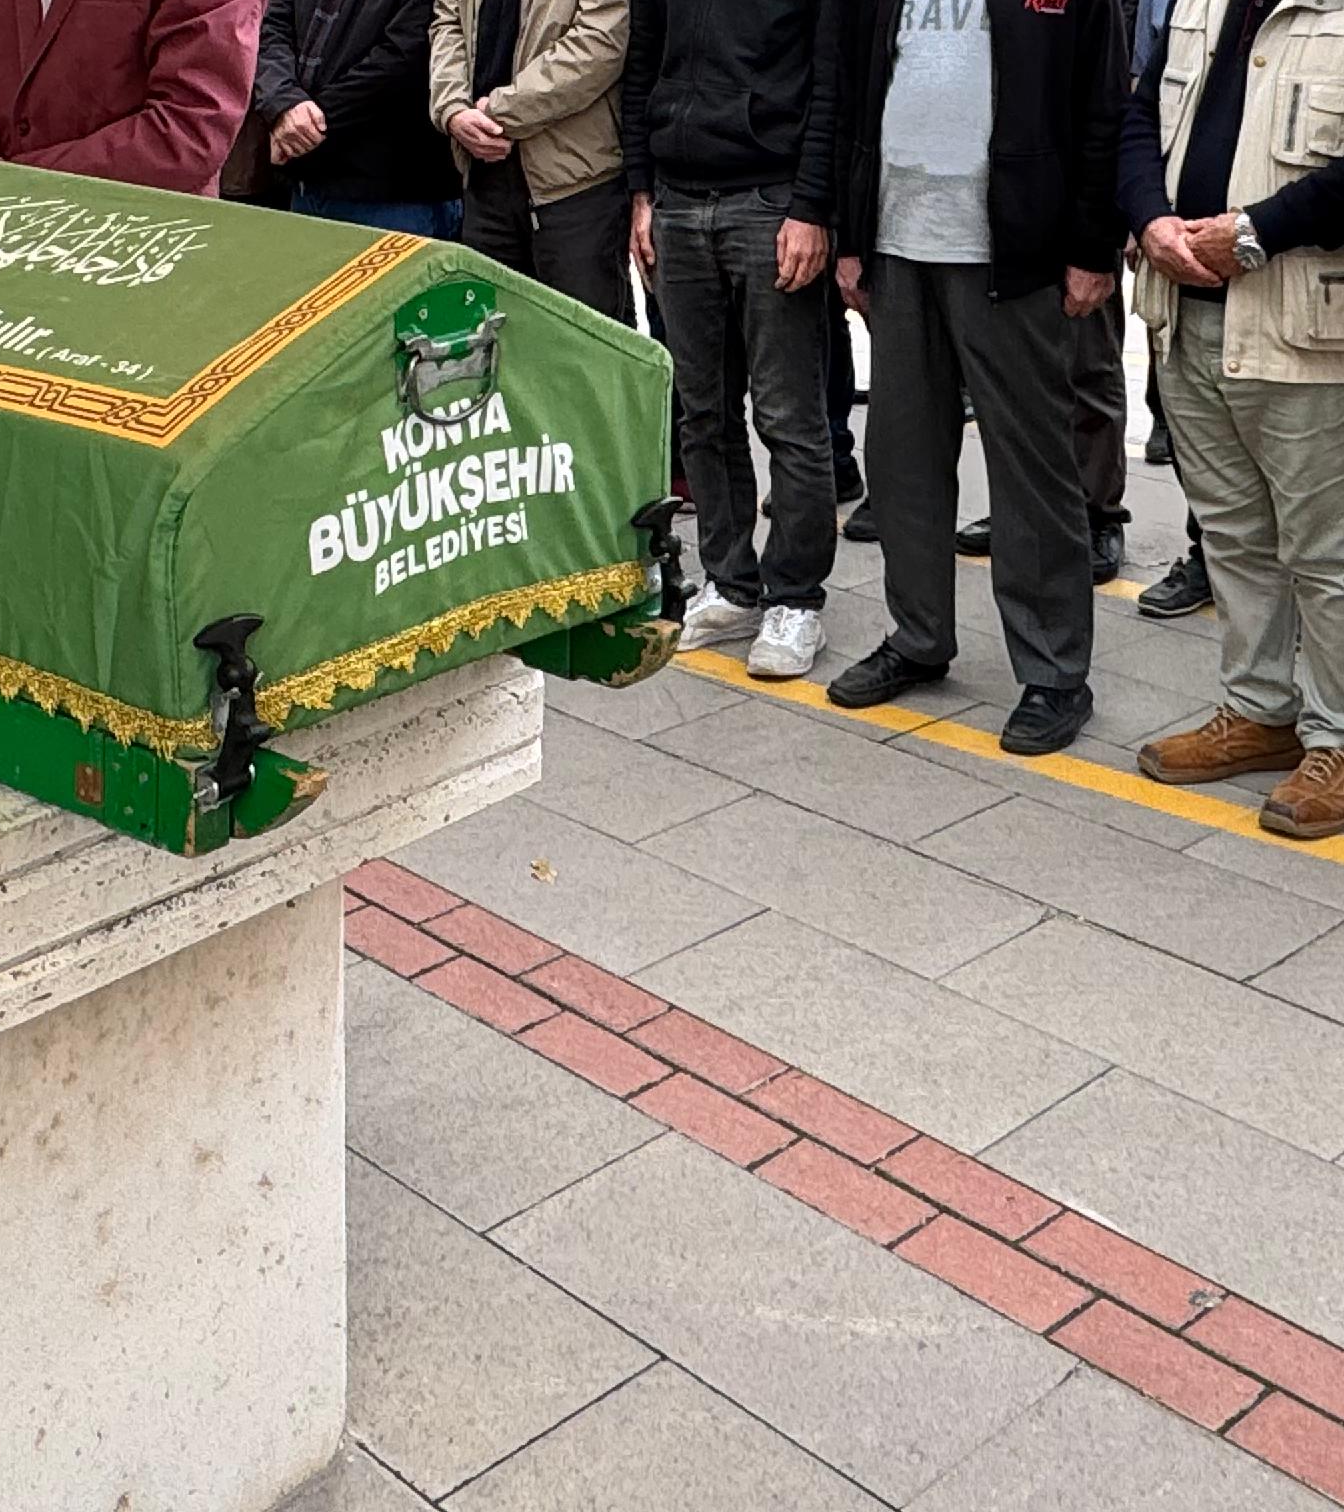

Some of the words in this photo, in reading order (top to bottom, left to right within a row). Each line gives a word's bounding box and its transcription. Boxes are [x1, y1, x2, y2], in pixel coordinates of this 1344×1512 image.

[381, 392, 512, 474] KONYA
[308, 433, 576, 576] BÜYÜKŞEHİR
[374, 502, 529, 596] BELEDİYESİ
